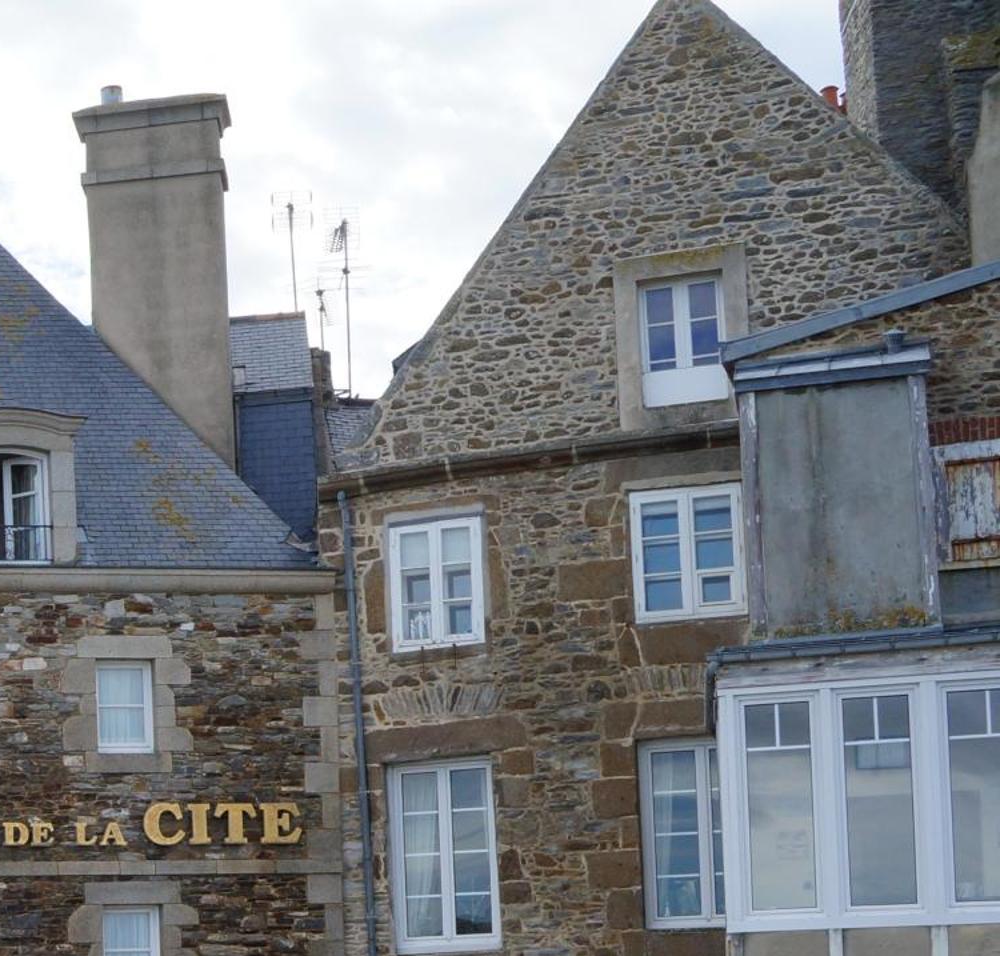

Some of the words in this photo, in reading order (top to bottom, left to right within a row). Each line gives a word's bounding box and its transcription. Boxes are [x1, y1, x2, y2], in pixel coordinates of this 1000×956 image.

[2, 821, 53, 846] DE
[73, 821, 128, 846] LA
[143, 802, 302, 846] CITE
